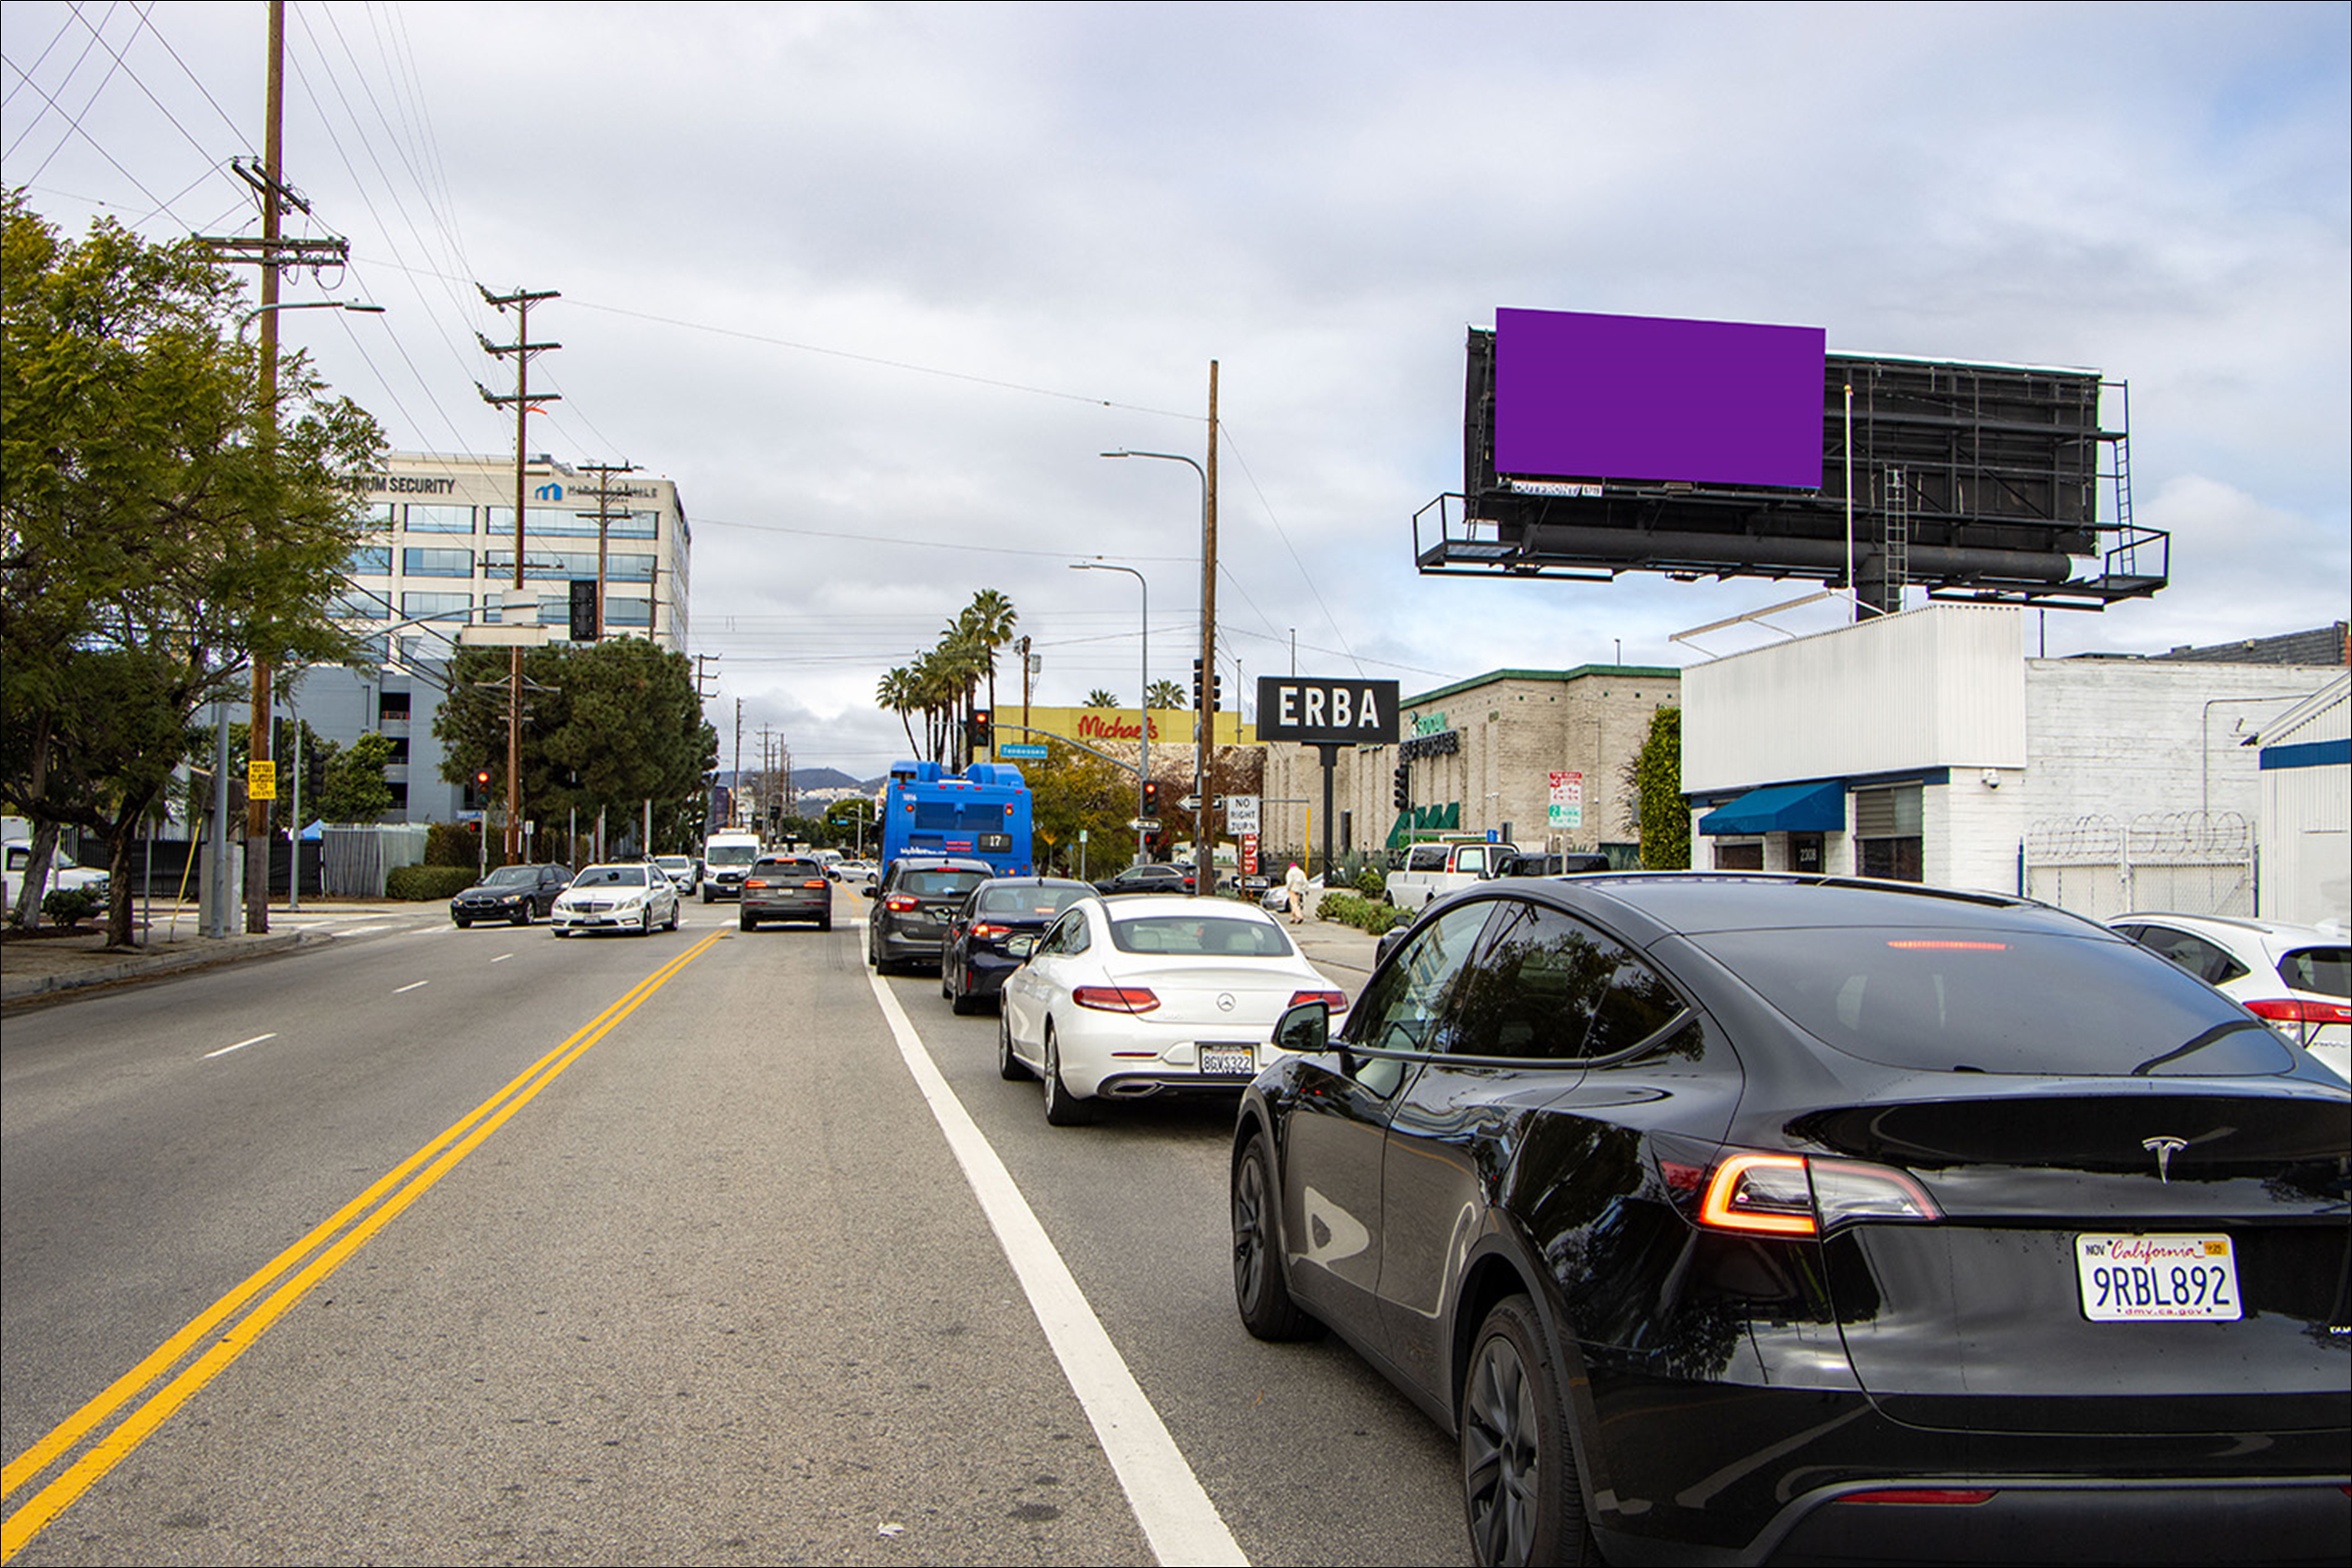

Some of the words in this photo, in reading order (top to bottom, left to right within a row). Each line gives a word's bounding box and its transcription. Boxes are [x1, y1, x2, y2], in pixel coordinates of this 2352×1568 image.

[389, 476, 455, 494] SECURITY
[1279, 685, 1380, 728] ERBA
[1235, 798, 1250, 808] NO
[1230, 810, 1256, 819] RIGHT
[990, 835, 1002, 847] 17
[2085, 1245, 2105, 1255] NOV
[2111, 1240, 2205, 1265] California
[2093, 1266, 2230, 1306] 9RBL892
